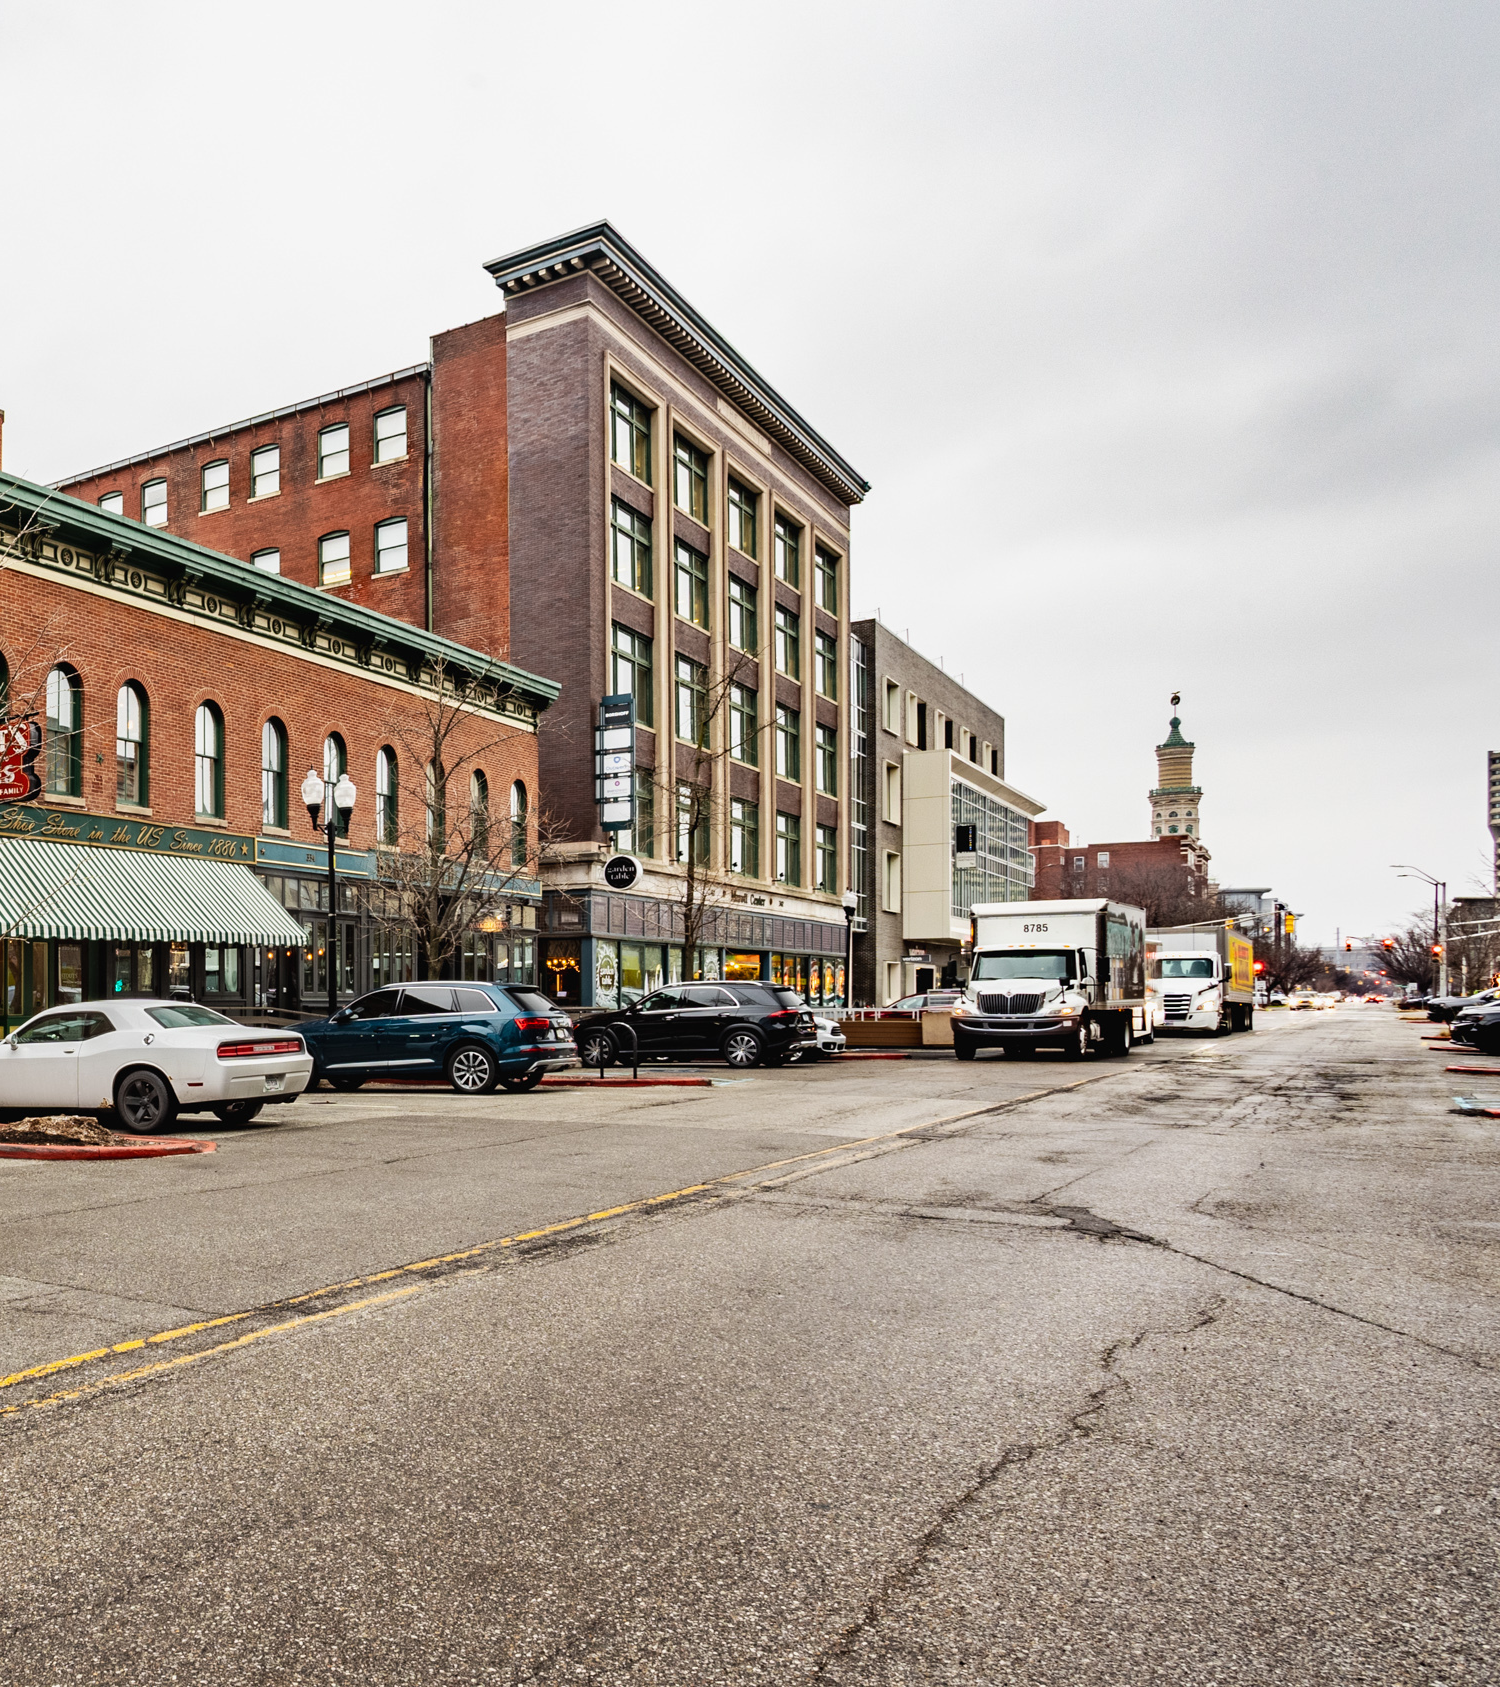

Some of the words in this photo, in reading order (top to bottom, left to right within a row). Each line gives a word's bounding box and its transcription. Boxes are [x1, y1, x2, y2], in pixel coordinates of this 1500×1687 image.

[0, 786, 25, 797] FAMILY
[41, 813, 81, 838] Store
[87, 825, 103, 840] in
[110, 825, 132, 843] the
[136, 826, 165, 847] US
[169, 830, 203, 852] Since
[207, 838, 236, 858] 1886
[1023, 923, 1049, 933] 8785
